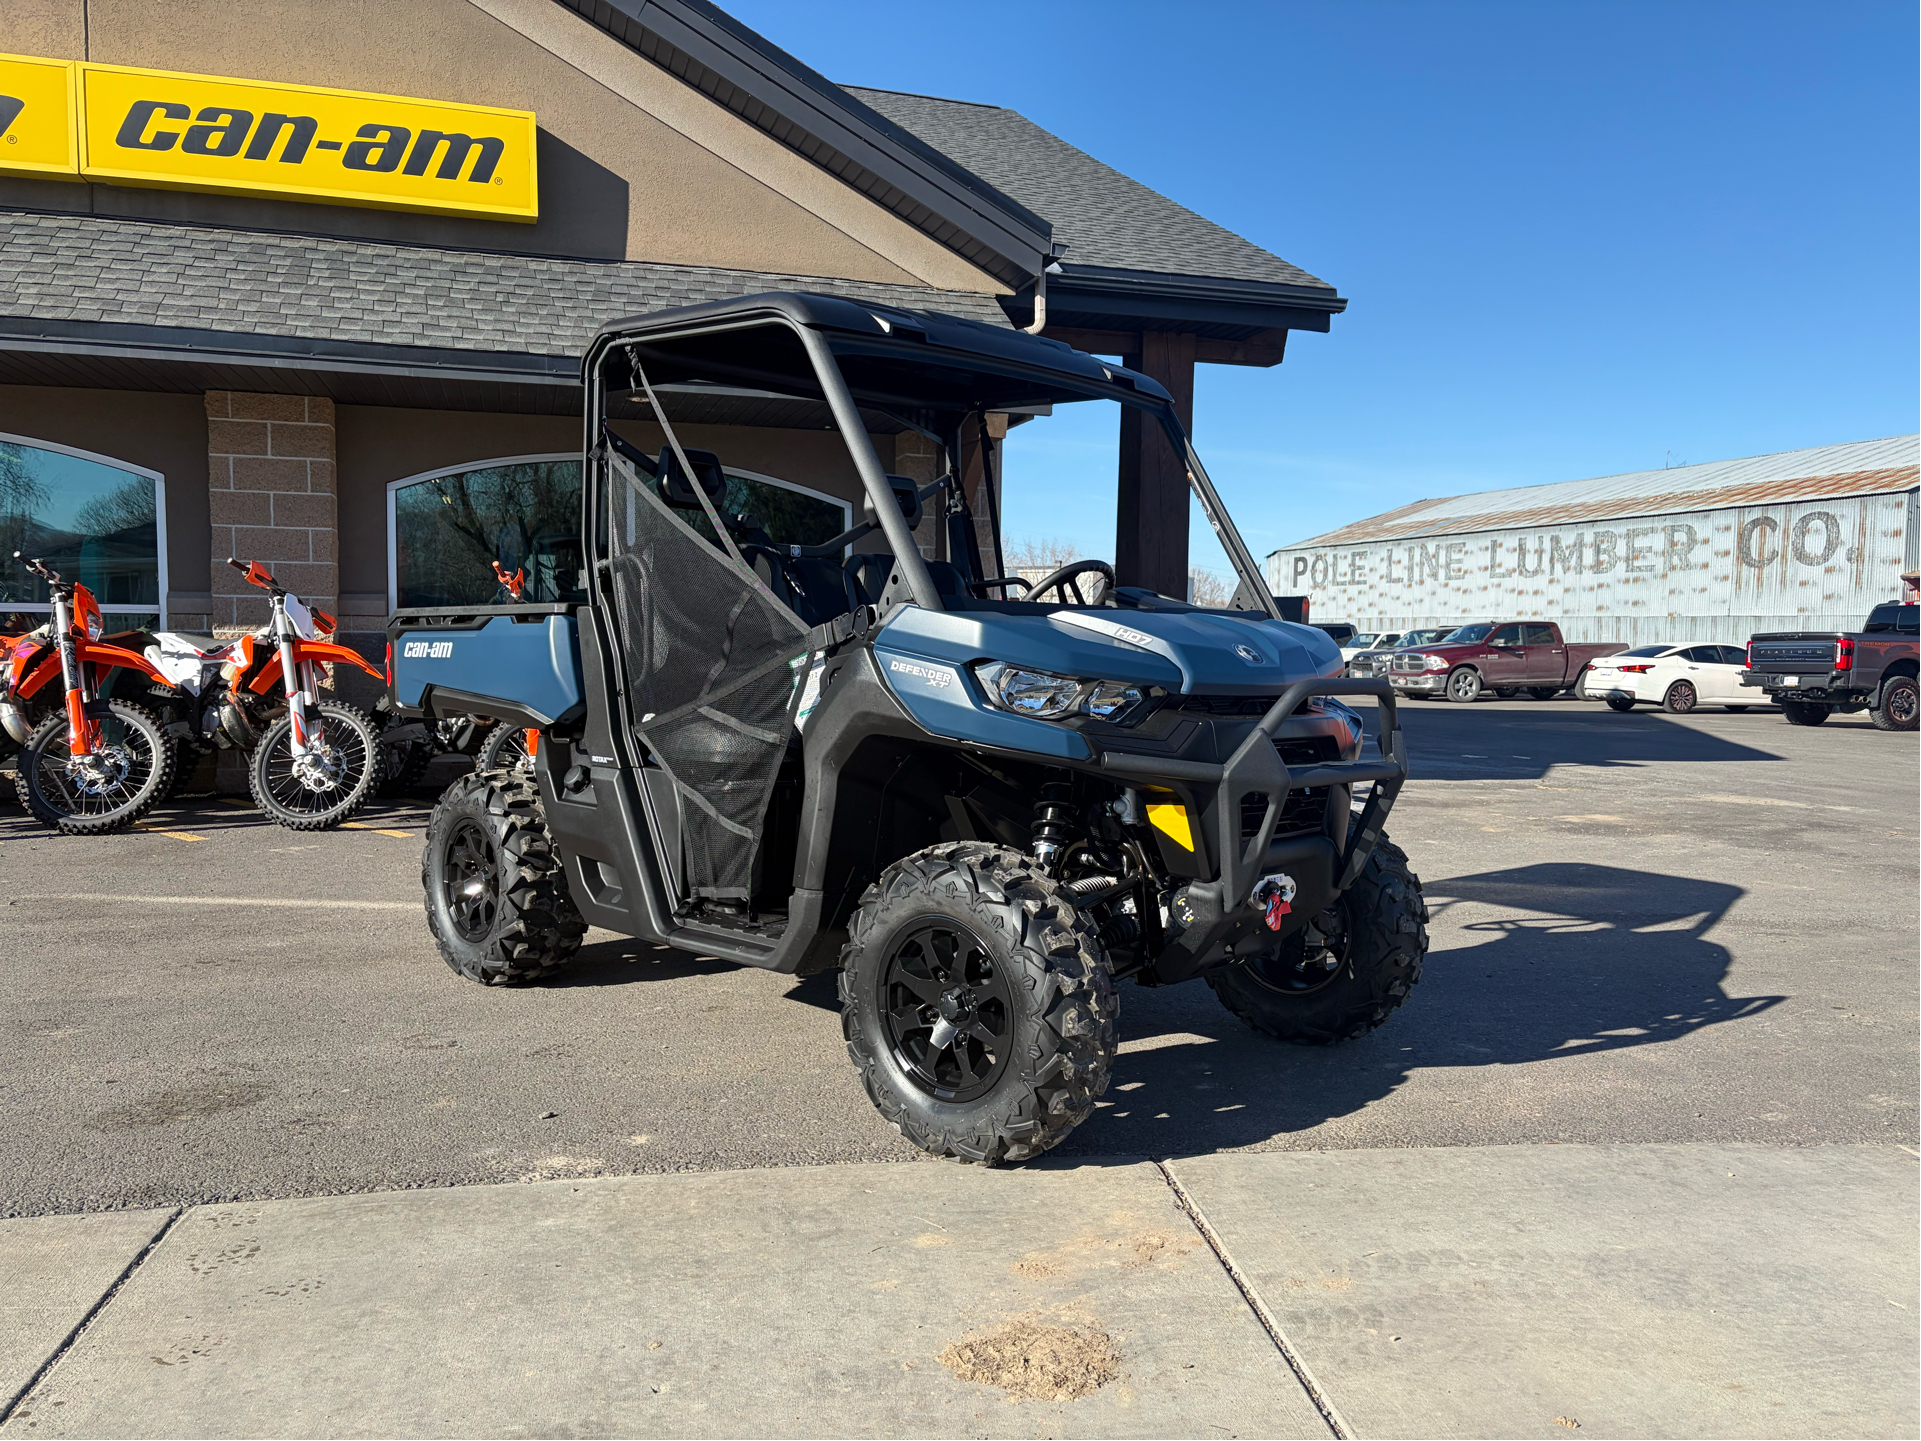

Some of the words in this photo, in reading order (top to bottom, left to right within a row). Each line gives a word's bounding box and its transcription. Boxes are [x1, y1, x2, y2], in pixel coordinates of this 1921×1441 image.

[115, 99, 505, 184] can-am
[1292, 550, 1368, 589] POLE
[1386, 542, 1466, 584] LINE
[1489, 523, 1698, 579] LUMBER
[1739, 510, 1858, 569] CO.
[1115, 628, 1153, 645] HD7
[403, 641, 453, 658] can-am
[890, 660, 952, 682] DEFENDER
[925, 679, 949, 689] XT
